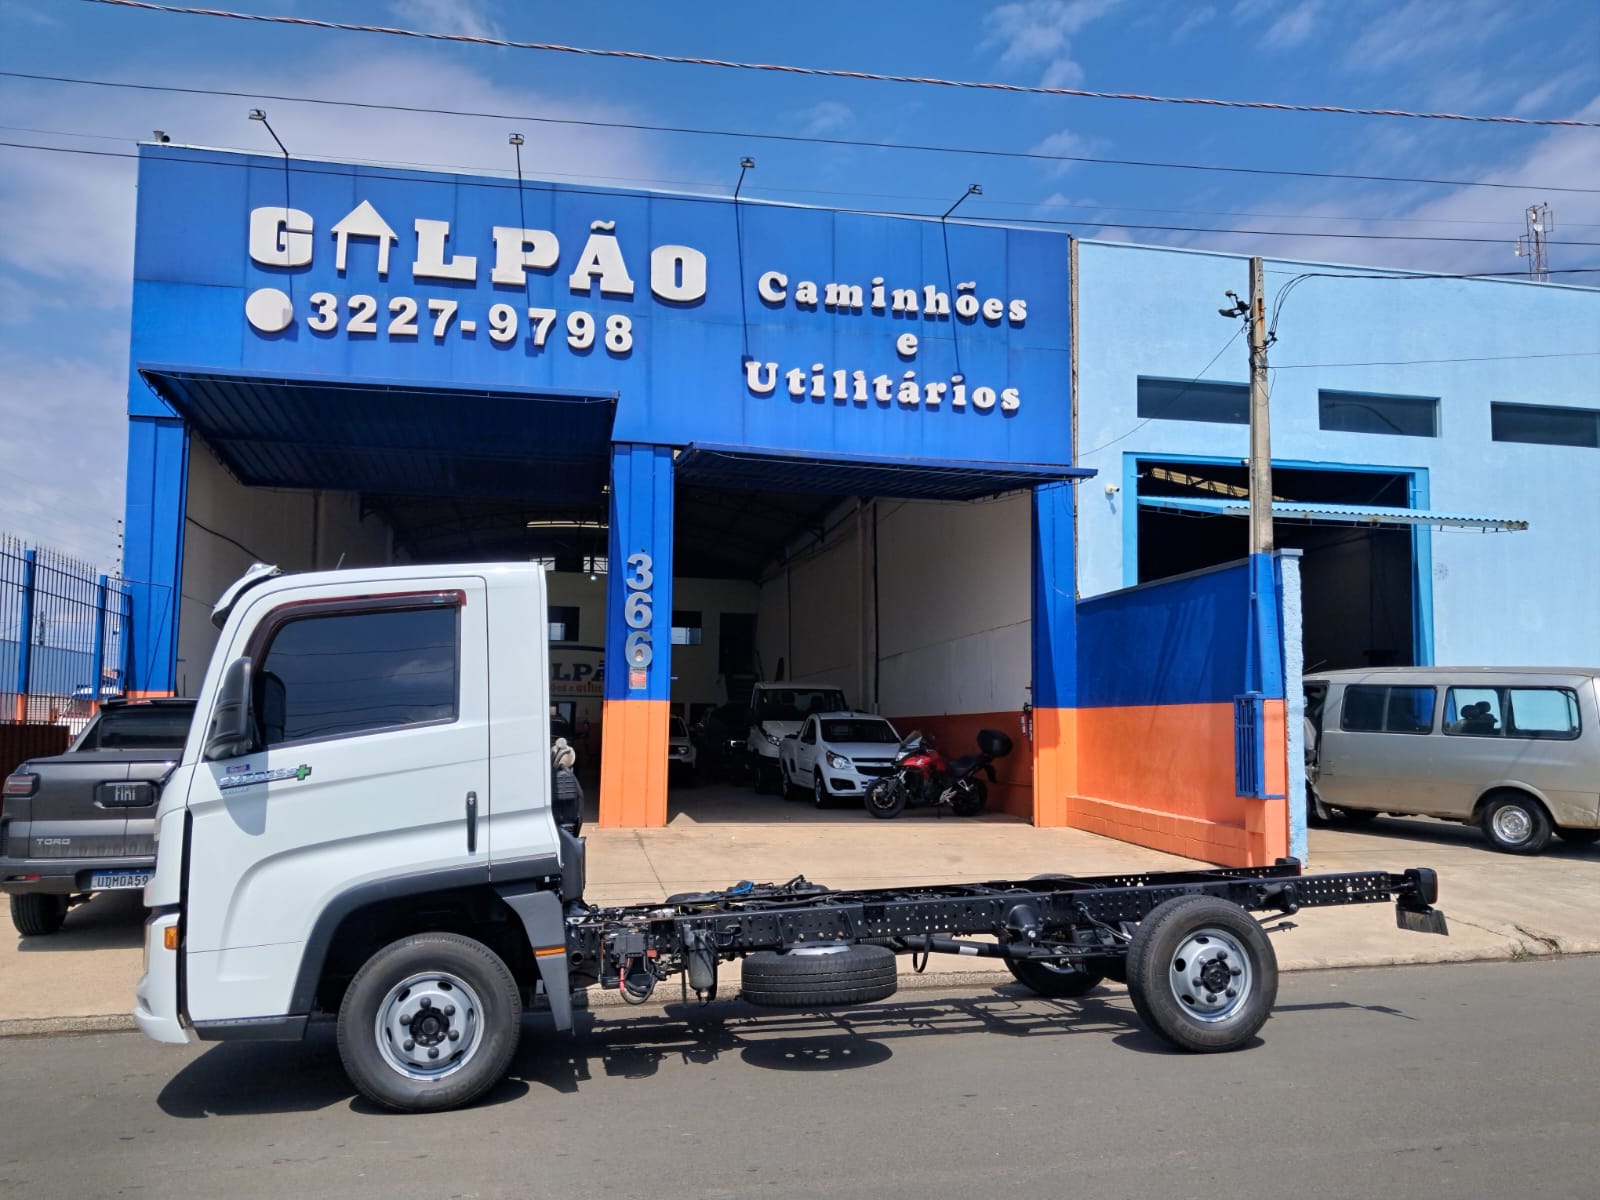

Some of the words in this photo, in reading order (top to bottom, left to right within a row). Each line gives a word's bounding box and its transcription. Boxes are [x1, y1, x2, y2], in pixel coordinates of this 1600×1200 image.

[758, 271, 1027, 322] Caminhões
[306, 292, 634, 353] 3227-9798
[897, 333, 918, 355] e
[745, 361, 1021, 410] Utilitários
[625, 553, 653, 668] 366
[115, 785, 136, 800] FIAT
